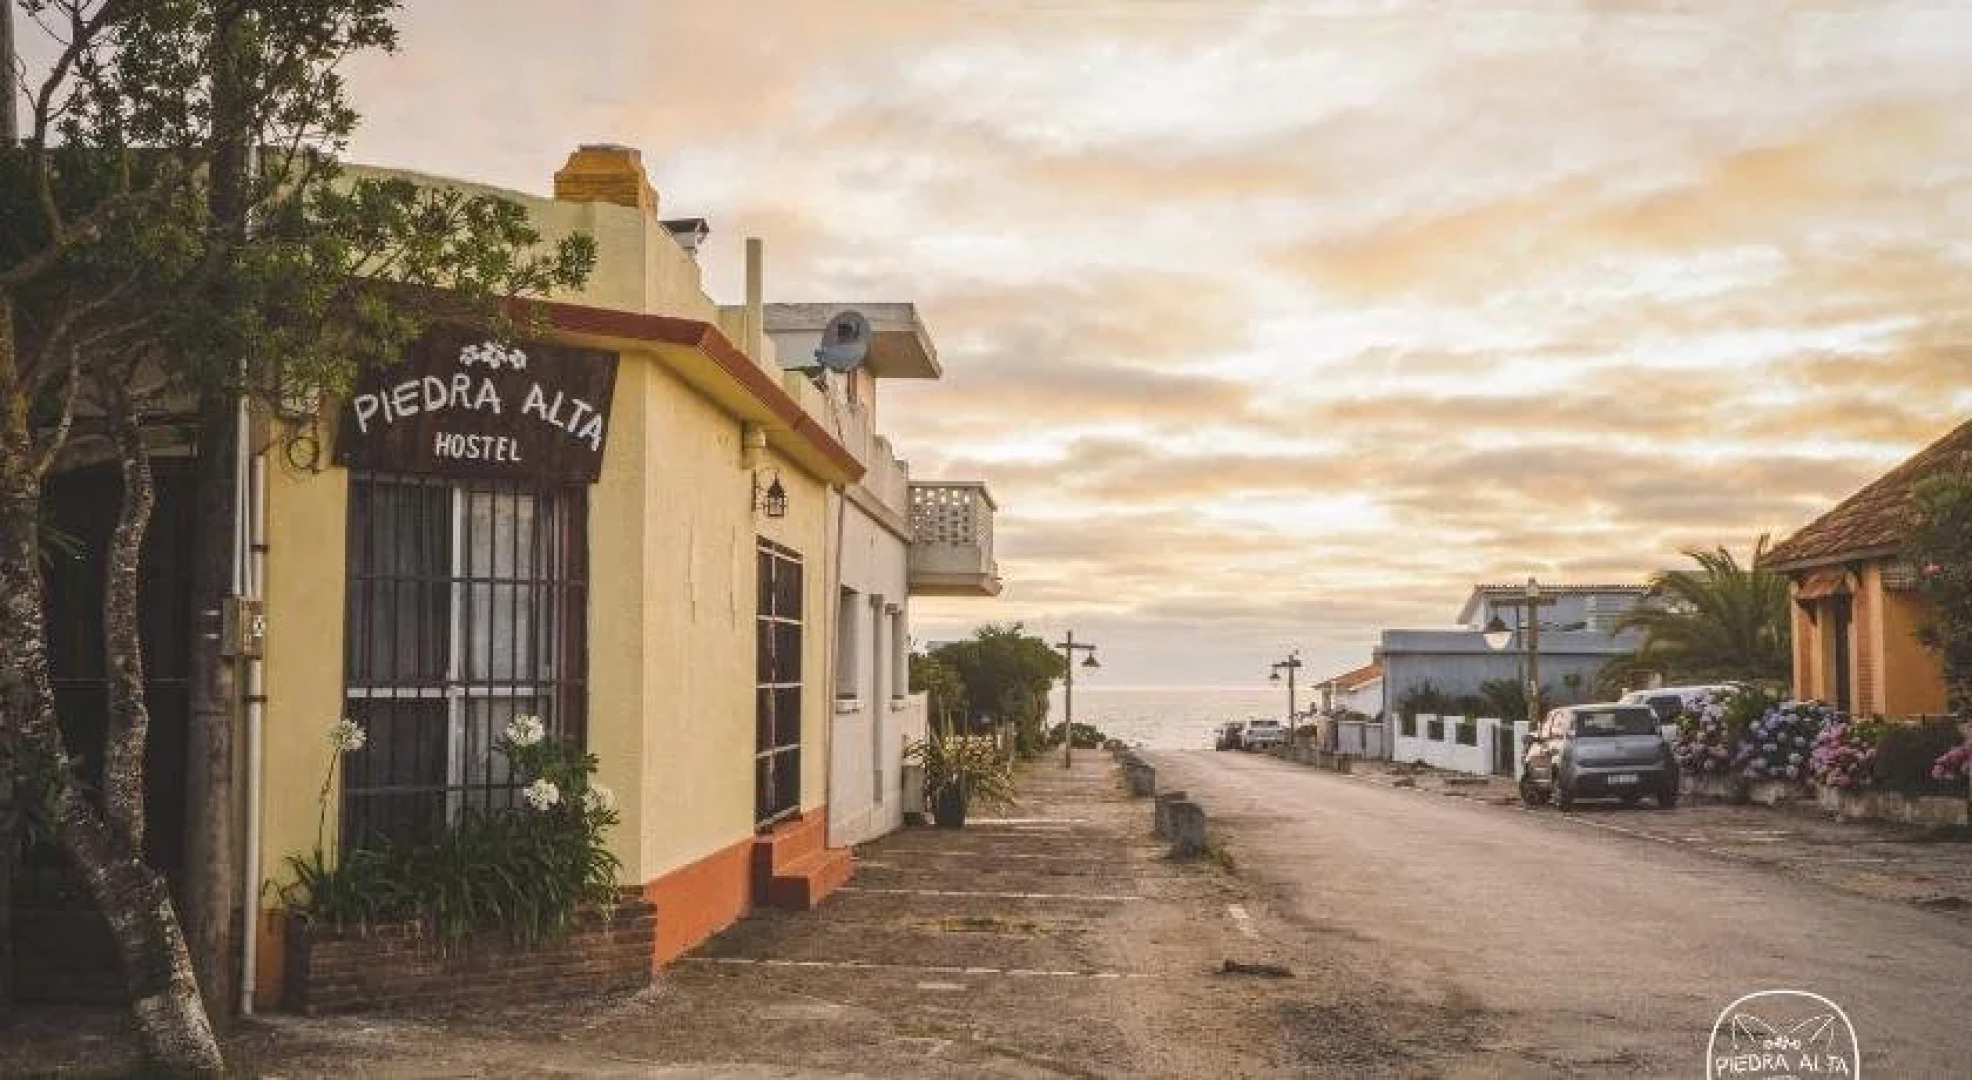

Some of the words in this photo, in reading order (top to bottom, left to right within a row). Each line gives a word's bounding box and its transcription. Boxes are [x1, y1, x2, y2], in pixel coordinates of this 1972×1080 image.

[354, 373, 500, 432] PIEDRA
[521, 382, 602, 451] ALTA
[435, 432, 521, 461] HOSTEL
